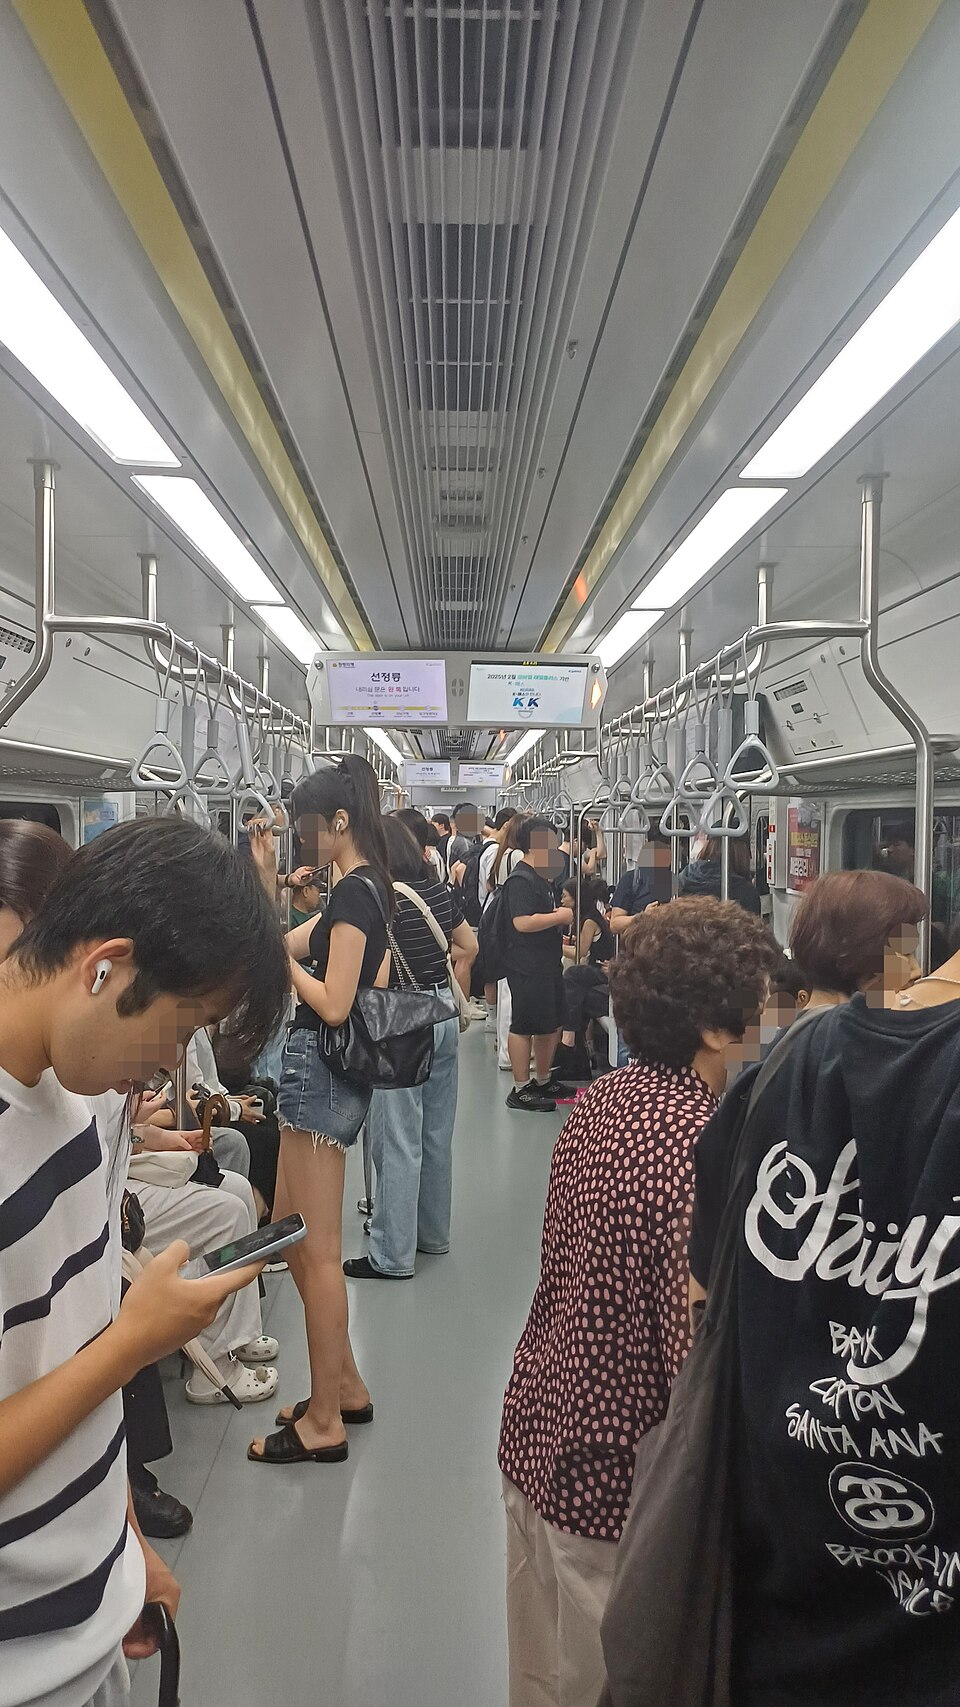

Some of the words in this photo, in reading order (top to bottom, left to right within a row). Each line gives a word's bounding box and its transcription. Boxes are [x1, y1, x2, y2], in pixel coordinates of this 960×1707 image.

[371, 672, 401, 682] 선정릉
[786, 1402, 862, 1458] SANTA
[870, 1422, 944, 1459] ANA
